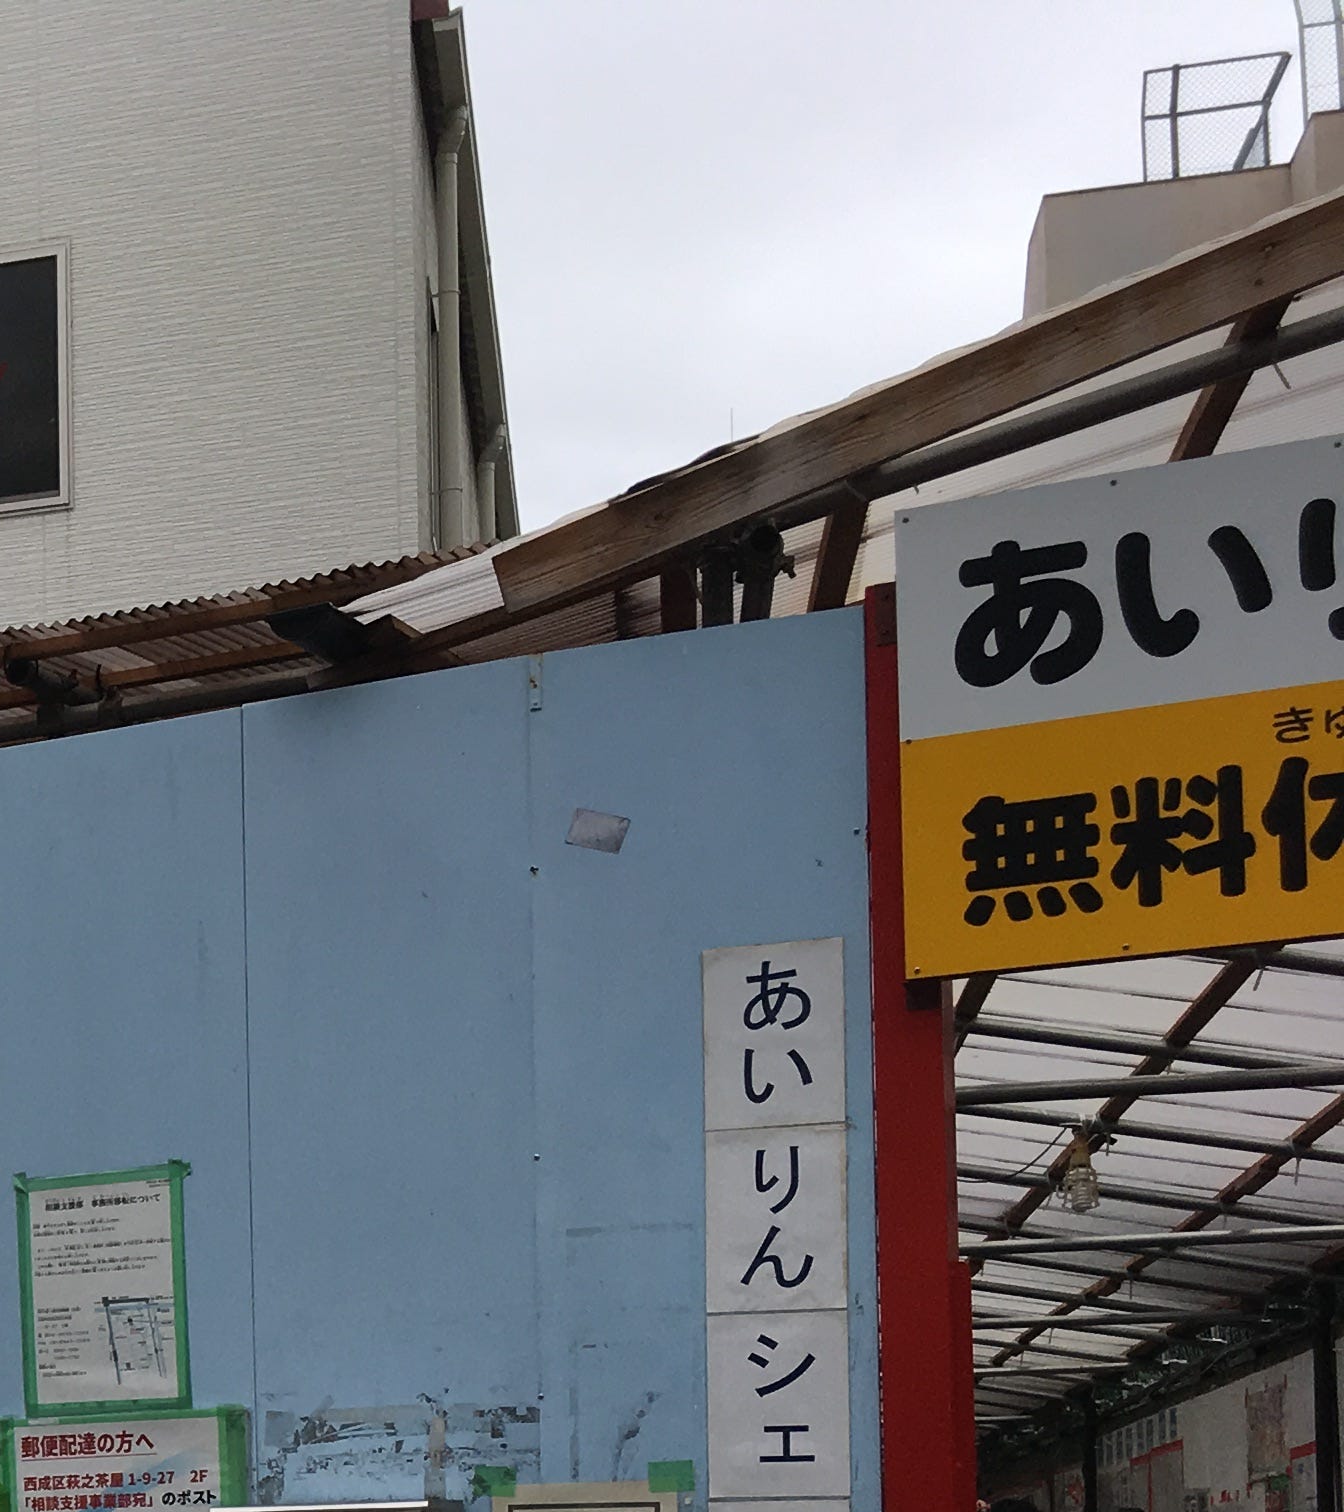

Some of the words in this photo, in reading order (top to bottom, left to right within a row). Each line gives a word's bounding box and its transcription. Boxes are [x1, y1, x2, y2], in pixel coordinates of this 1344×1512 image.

[20, 1431, 155, 1459] 郵便配達の方へ
[23, 1473, 124, 1492] 西成区萩之茶屋
[128, 1471, 175, 1487] 1-9-27
[189, 1469, 209, 1483] 2F
[161, 1491, 217, 1507] のポスト
